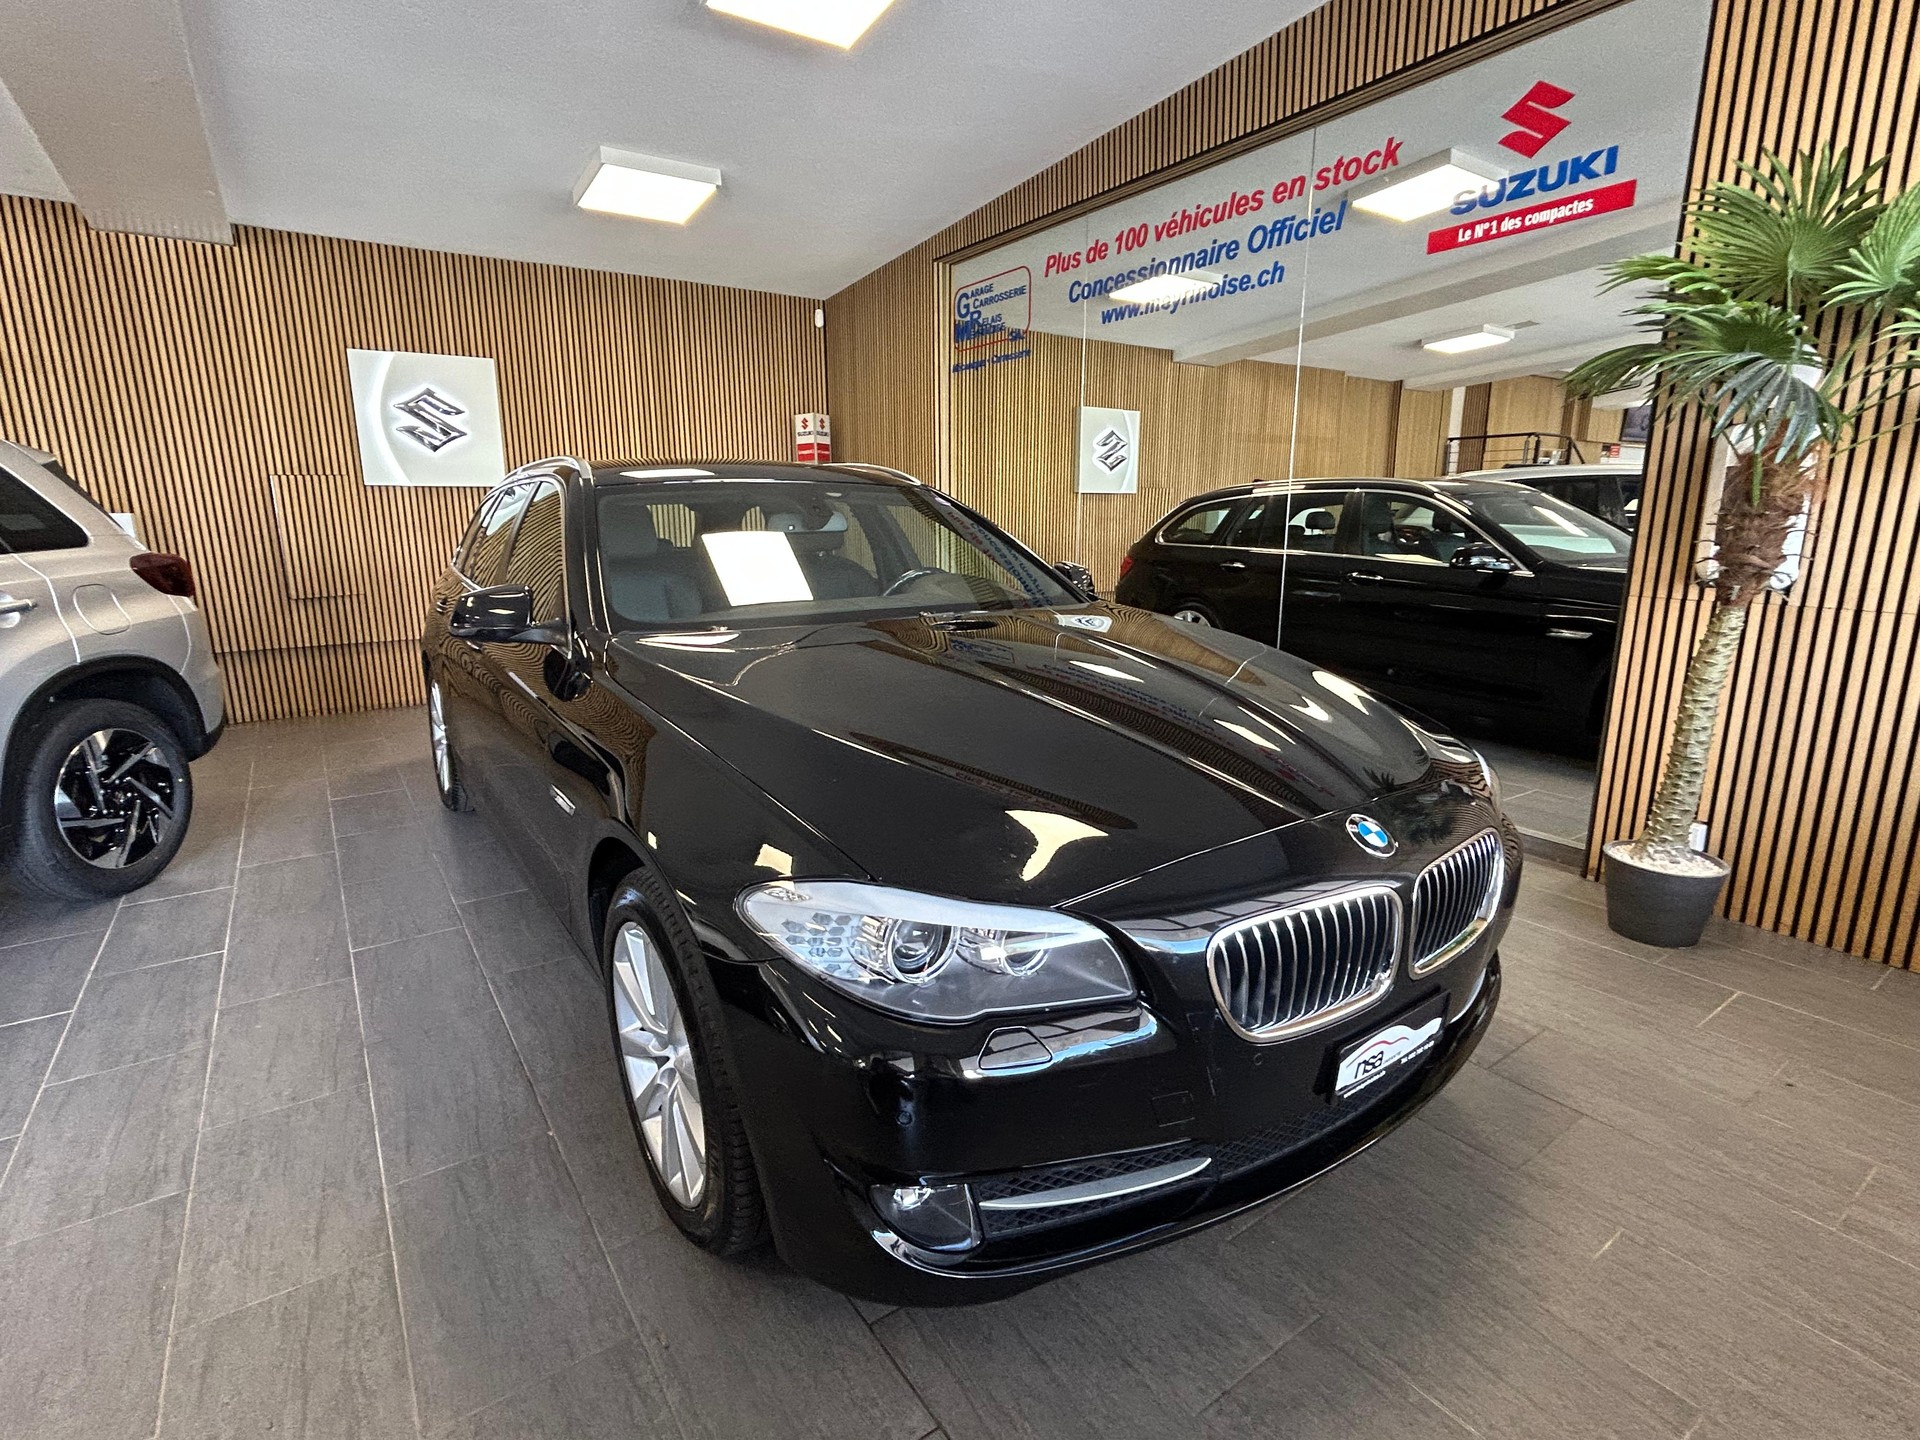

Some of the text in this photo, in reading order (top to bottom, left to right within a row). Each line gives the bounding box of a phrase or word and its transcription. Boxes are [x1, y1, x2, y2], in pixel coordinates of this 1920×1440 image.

[1044, 136, 1403, 278] Plus de 100 véhicules en stock
[1450, 145, 1620, 216] SUZUKI
[1069, 199, 1348, 303] Concessionnaire Officiel
[1457, 228, 1472, 243] Le
[1500, 216, 1523, 233] des
[1524, 198, 1594, 224] compactes
[973, 285, 1028, 310] CARROSSERIE
